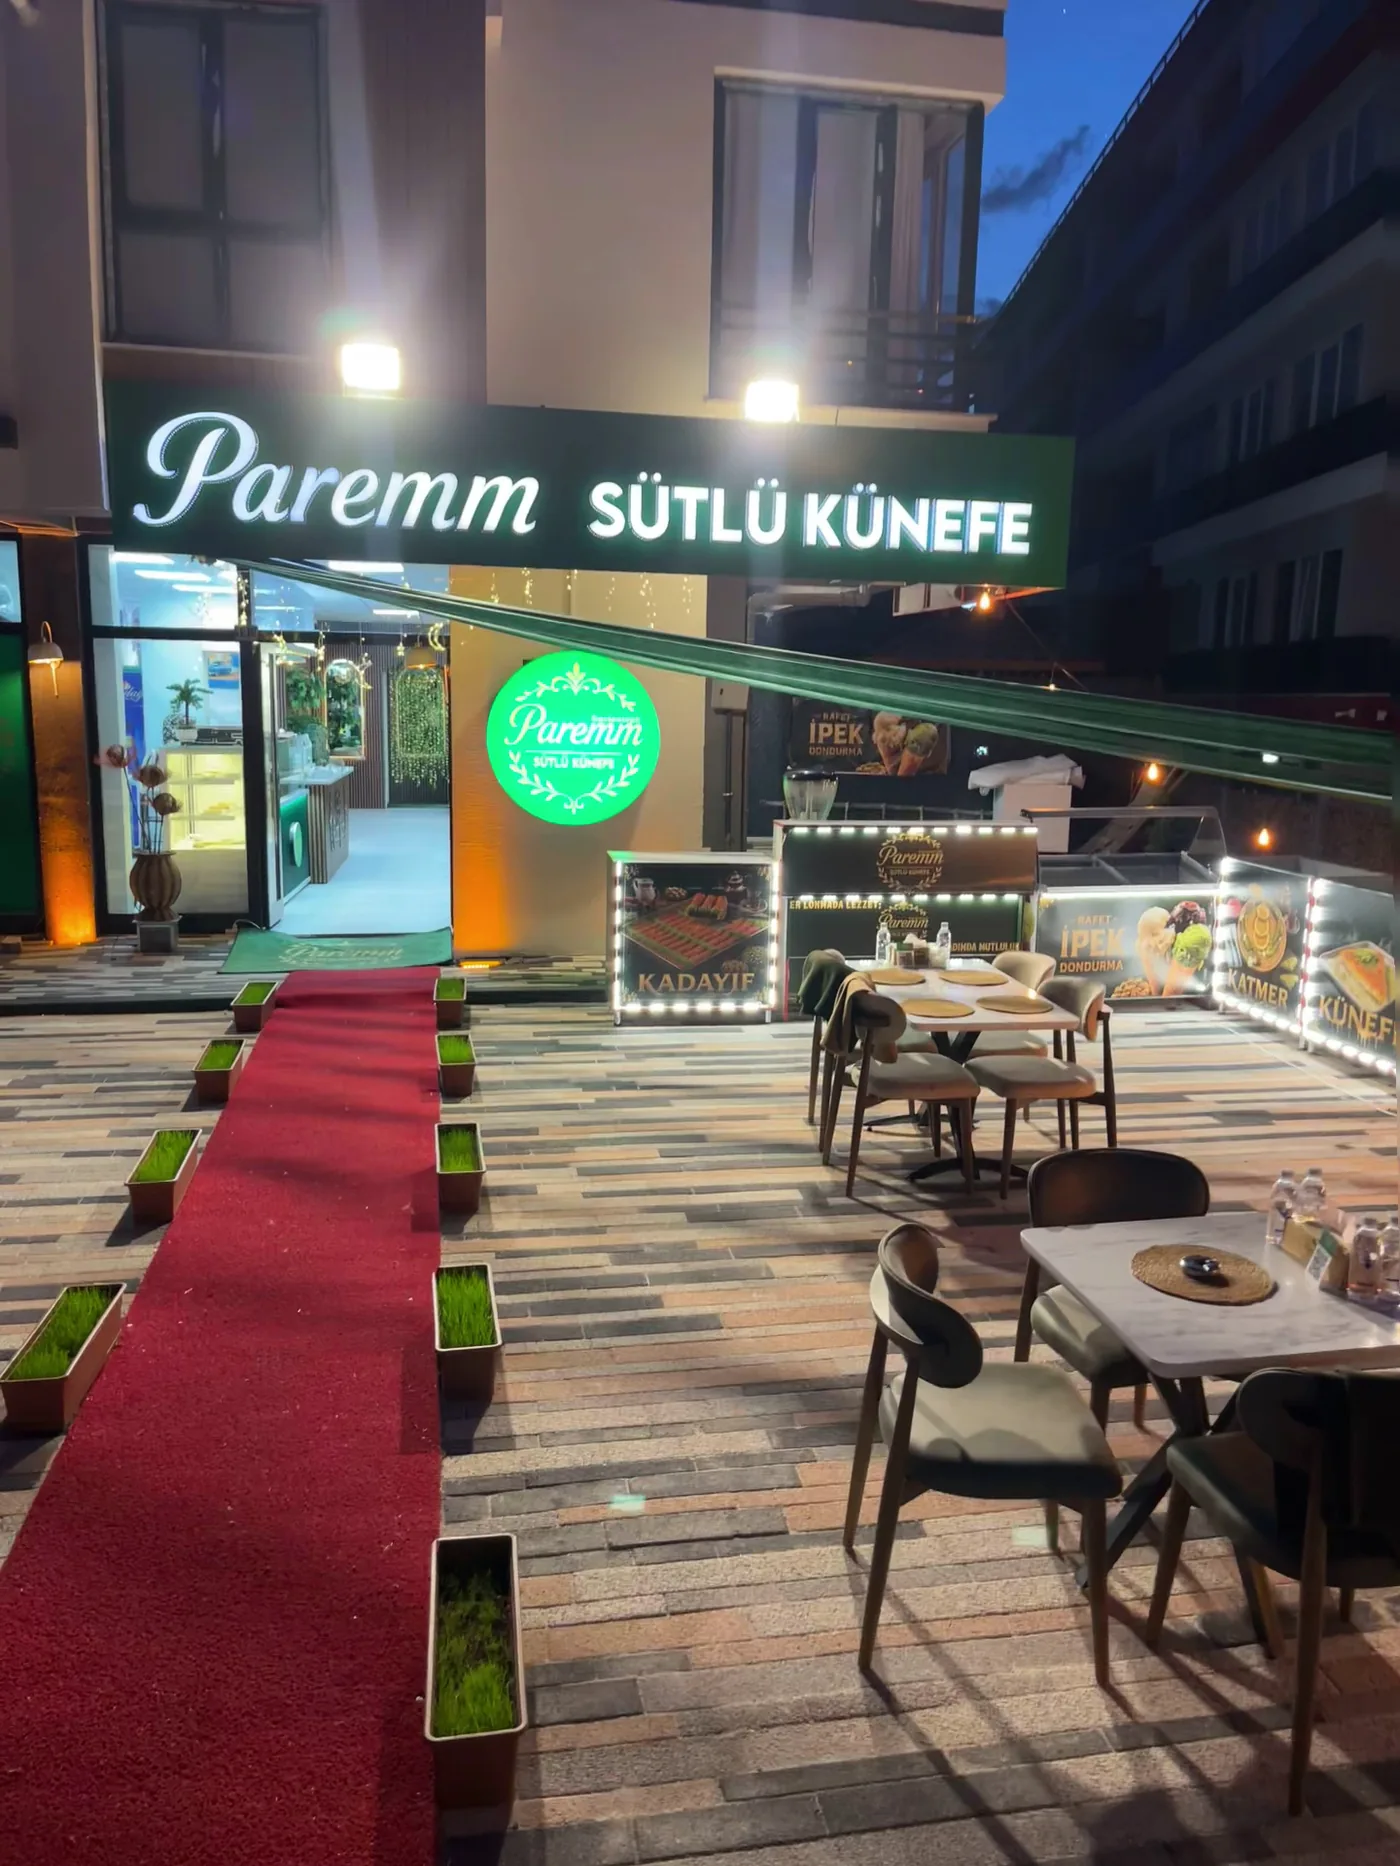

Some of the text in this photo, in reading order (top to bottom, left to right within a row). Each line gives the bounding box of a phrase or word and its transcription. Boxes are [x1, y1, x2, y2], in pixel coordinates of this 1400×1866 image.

[132, 411, 540, 536] Paremm
[588, 471, 1033, 555] SÜTLÜ KÜNEFE
[504, 703, 643, 746] Paremm
[809, 719, 864, 745] İPEK
[876, 845, 944, 866] Paremm
[1060, 925, 1126, 958] İPEK
[638, 973, 756, 993] KADAYIF
[1060, 960, 1124, 973] DONDURMA
[1228, 968, 1289, 1008] KATMER
[1319, 994, 1397, 1046] KÜNEF
